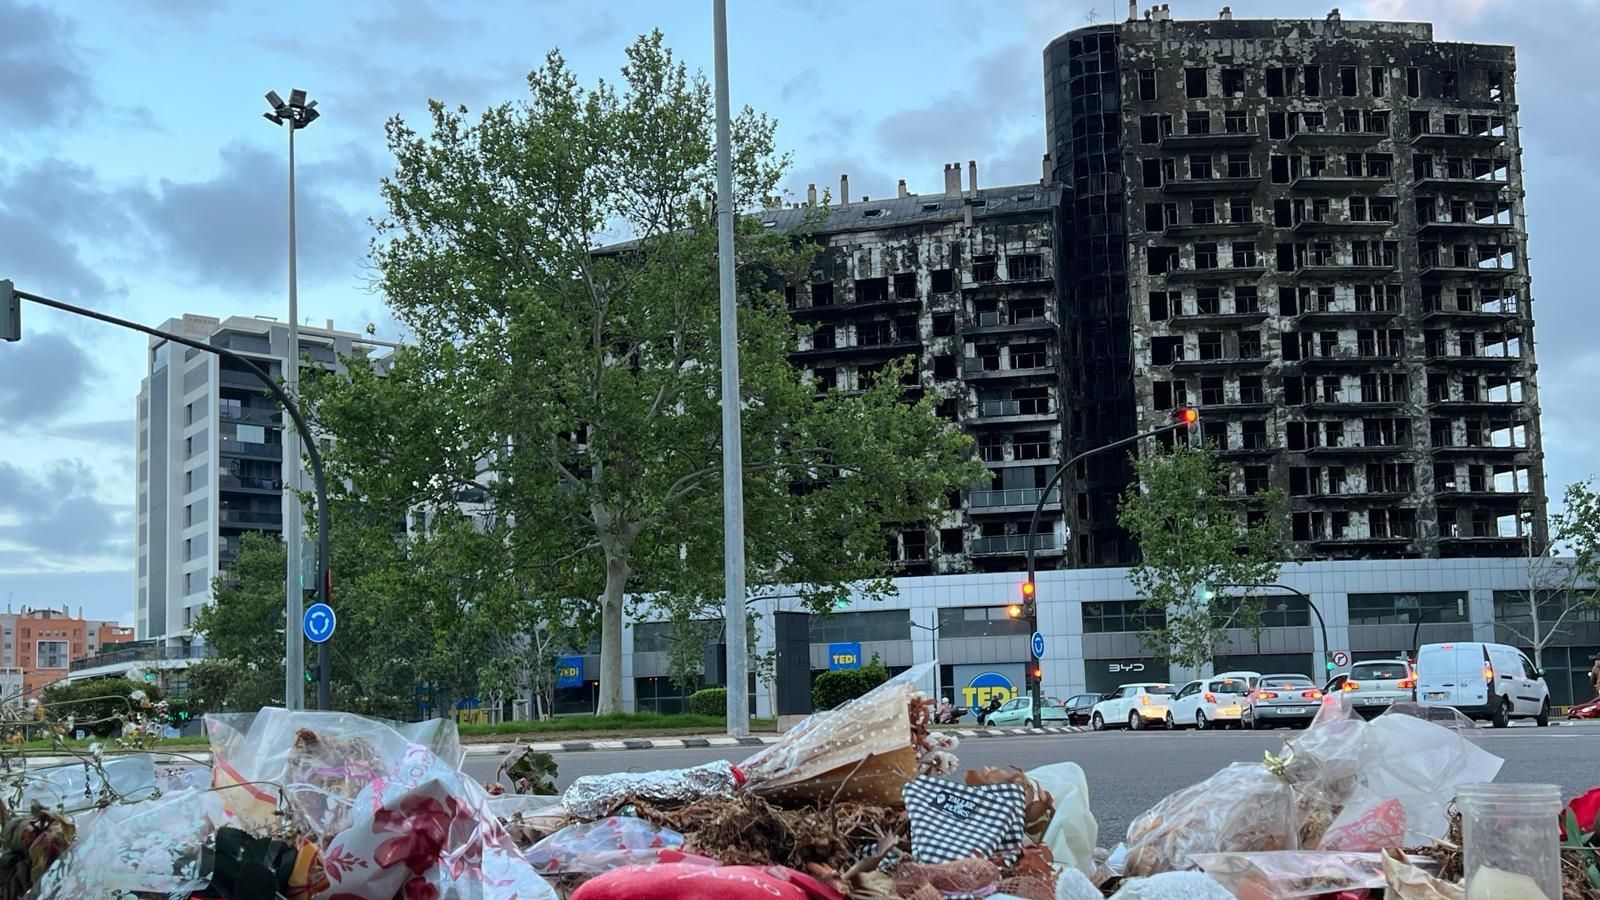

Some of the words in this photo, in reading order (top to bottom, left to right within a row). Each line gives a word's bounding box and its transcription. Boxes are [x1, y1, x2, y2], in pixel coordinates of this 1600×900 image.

[833, 654, 857, 665] TEDi
[1109, 663, 1144, 672] BYD
[962, 685, 1018, 708] TEDi
